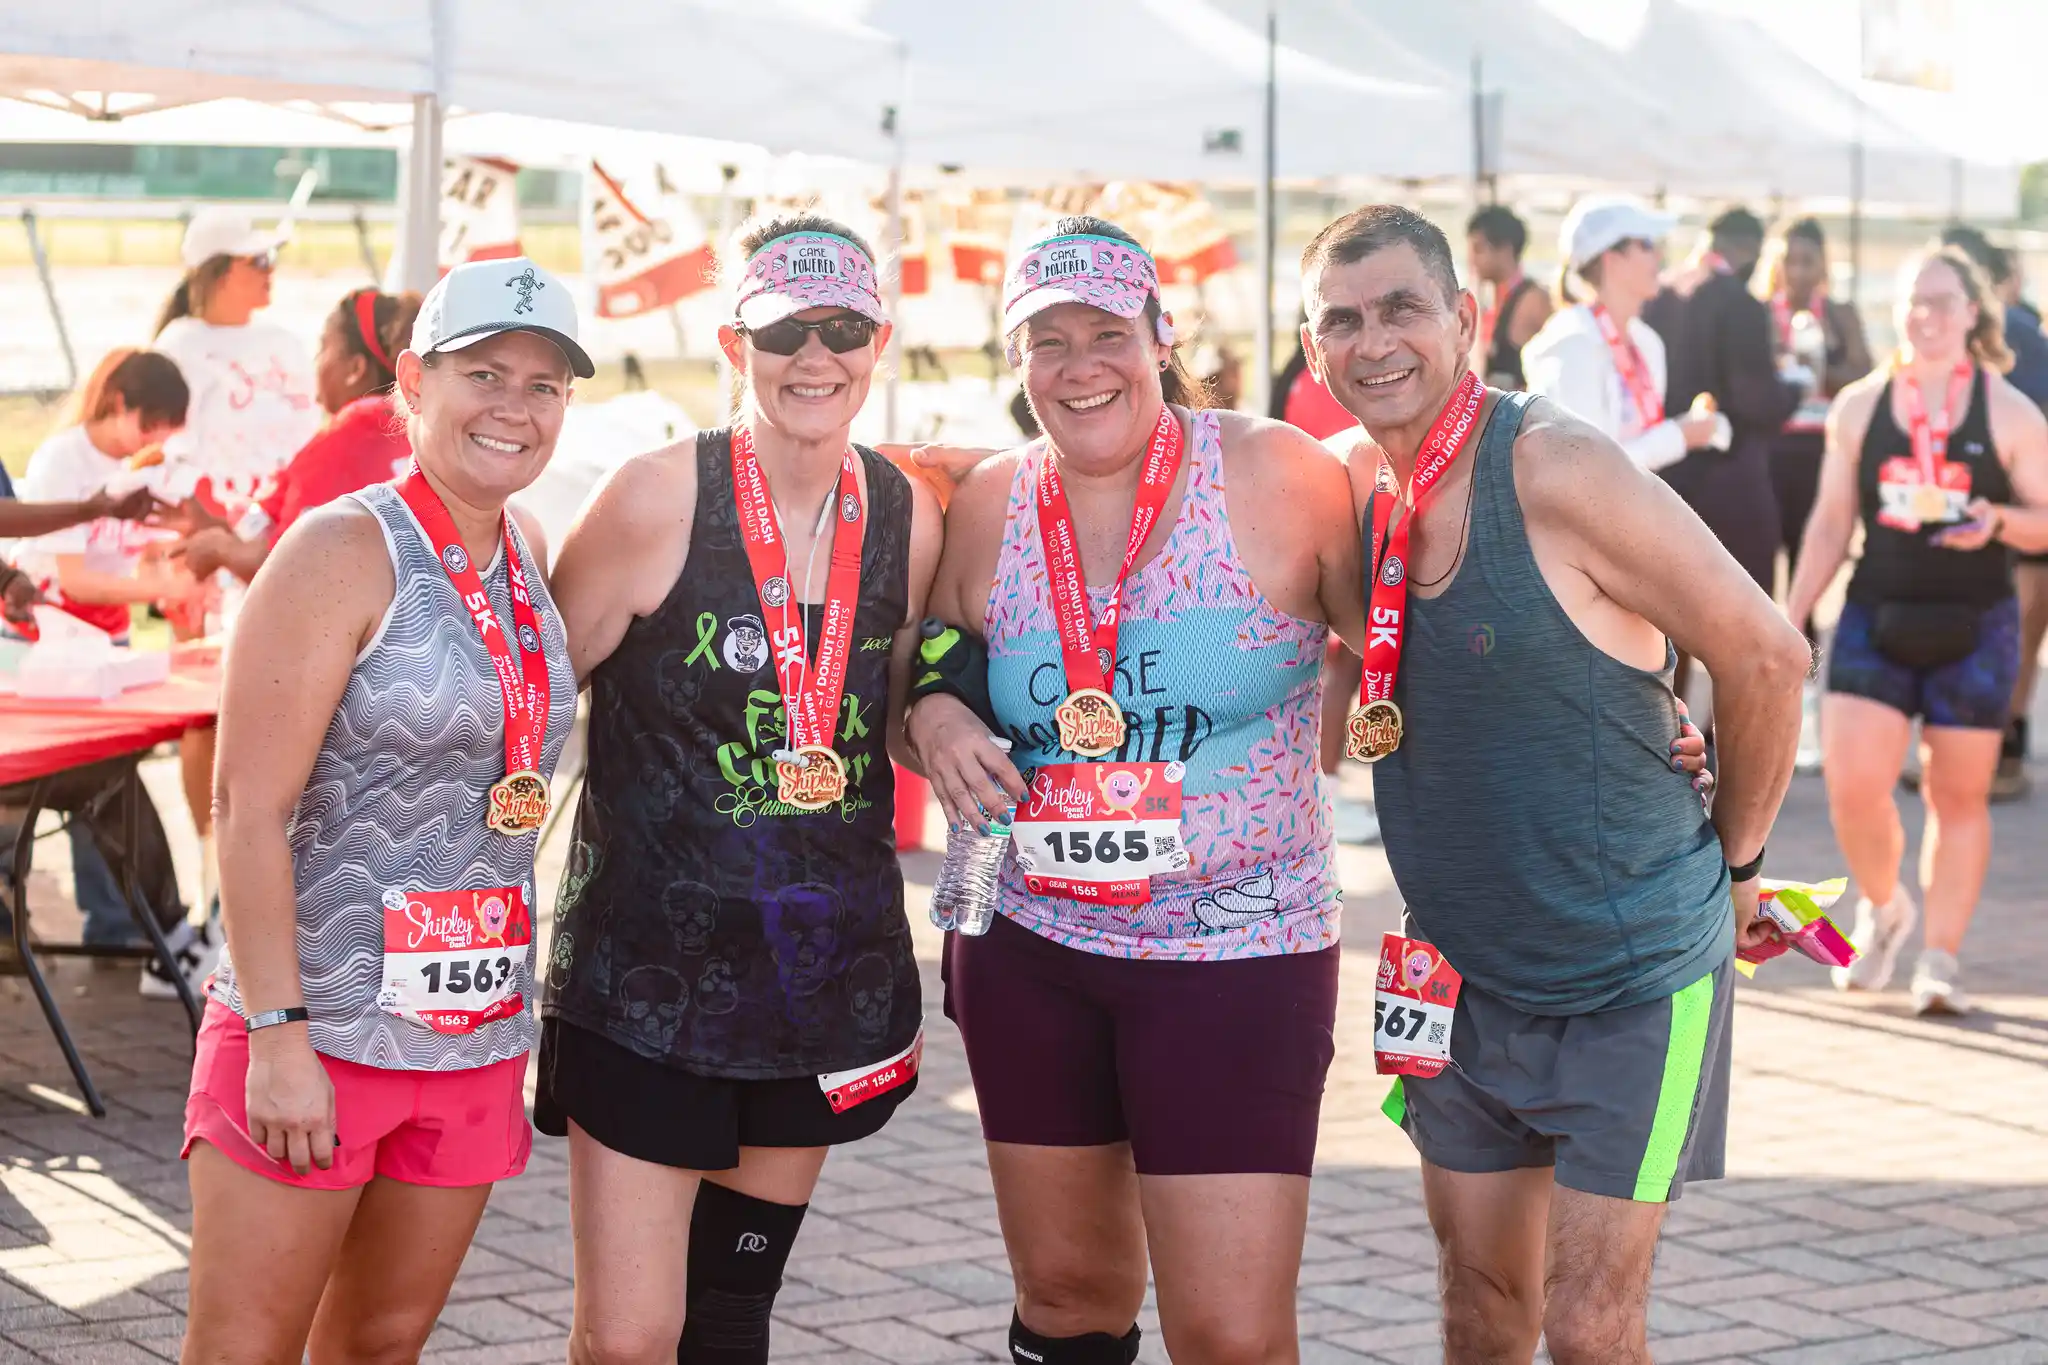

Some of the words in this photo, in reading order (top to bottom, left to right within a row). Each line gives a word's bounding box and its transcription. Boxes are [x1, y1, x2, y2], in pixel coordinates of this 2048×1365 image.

[793, 258, 836, 275] POWERED
[799, 247, 826, 258] CAKE
[1045, 259, 1088, 278] POWERED
[1051, 249, 1078, 261] CAKE
[1444, 393, 1466, 429] GLAZED
[1442, 412, 1472, 458] DONUT
[1145, 436, 1166, 486] SHIPLEY
[1159, 460, 1172, 484] HOT
[1416, 456, 1446, 486] DASH
[734, 444, 748, 488] GLAZED
[741, 491, 760, 542] DONUTS
[747, 457, 766, 505] DONUT
[757, 507, 776, 544] DASH
[1050, 476, 1060, 497] LIFE
[1134, 506, 1145, 528] LIFE
[1048, 530, 1060, 553] HOT
[1124, 506, 1154, 569] Delicious
[1053, 557, 1068, 600] GLAZED
[1056, 519, 1074, 568] SHIPLEY
[1066, 571, 1084, 616] DONUT
[1075, 618, 1091, 653] DASH
[465, 590, 499, 637] 5K
[1061, 603, 1078, 651] DONUTS
[1369, 606, 1399, 650] 5K
[773, 626, 804, 674] 5K
[816, 637, 834, 687] DONUT
[826, 599, 841, 635] DASH
[826, 660, 841, 709] GLAZED
[835, 607, 850, 658] DONUTS
[491, 654, 518, 720] Delicious
[503, 655, 519, 686] MAKE
[514, 686, 525, 710] LIFE
[1029, 651, 1167, 706] CKE
[803, 692, 817, 723] MAKE
[810, 724, 822, 745] LIFE
[1058, 706, 1124, 747] Shipley
[1348, 715, 1401, 757] Shipley
[778, 761, 848, 801] Shipley
[1029, 772, 1094, 818] Shipley
[489, 786, 551, 826] Shipley
[1145, 798, 1169, 812] 5K
[1044, 830, 1150, 864] 1565
[1048, 880, 1068, 889] GEAR
[1071, 885, 1098, 897] 1565
[1110, 882, 1141, 891] DO-NUT
[405, 900, 474, 949] Shipley
[509, 922, 525, 938] 5K
[420, 956, 511, 994] 1563
[1430, 981, 1454, 999] 5K
[438, 1015, 470, 1025] 1563
[849, 1079, 869, 1092] GEAR
[872, 1069, 898, 1087] 1564
